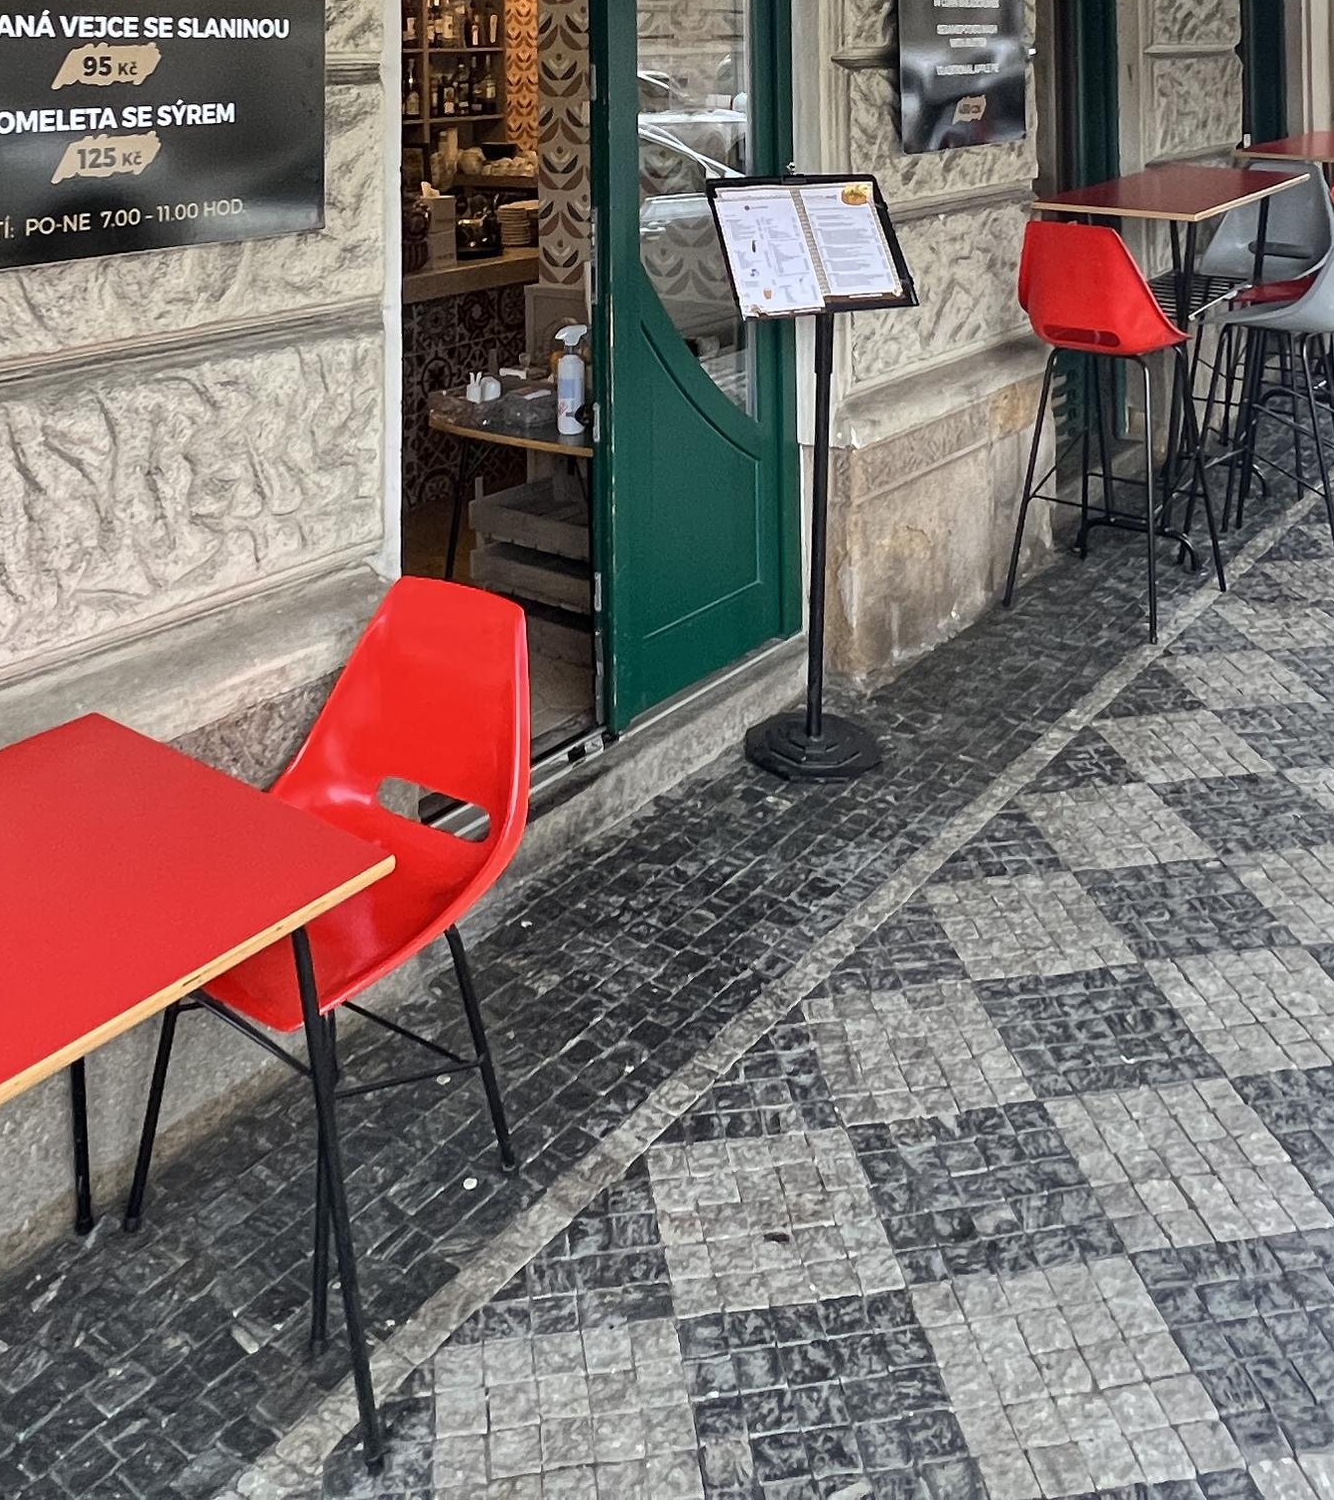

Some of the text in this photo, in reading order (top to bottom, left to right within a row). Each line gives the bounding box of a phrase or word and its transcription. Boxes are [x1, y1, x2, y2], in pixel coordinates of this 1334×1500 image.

[59, 15, 140, 38] VEJCE
[143, 16, 174, 39] SE
[177, 17, 290, 39] SLANINOU
[83, 56, 138, 77] 95 Kč
[121, 105, 153, 128] SE
[156, 99, 235, 127] SÝREM
[76, 146, 143, 170] 125 Kč
[25, 212, 92, 237] PO-NE
[100, 207, 141, 229] 7.00
[156, 202, 200, 222] 11.00
[203, 198, 247, 217] HOD.
